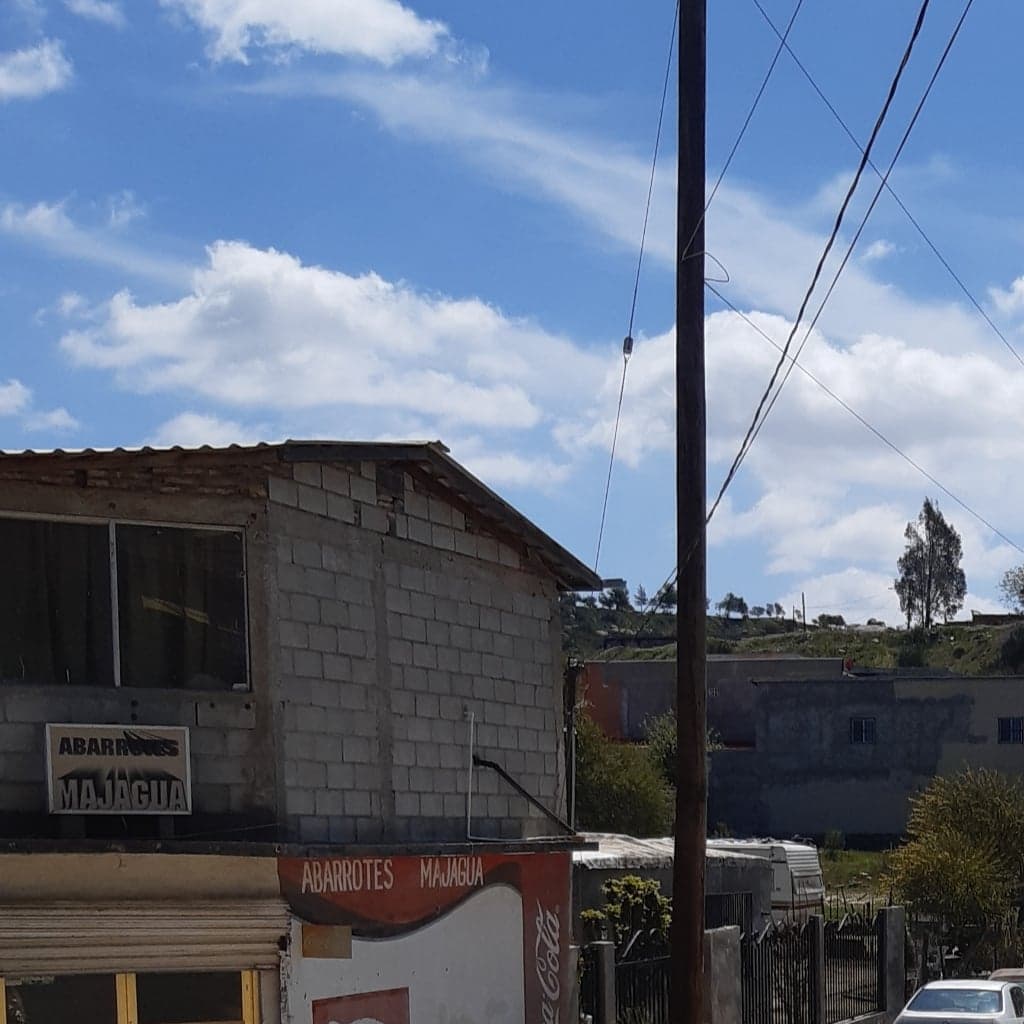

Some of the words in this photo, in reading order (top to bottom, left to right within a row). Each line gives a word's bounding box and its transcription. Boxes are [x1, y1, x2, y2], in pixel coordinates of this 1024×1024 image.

[58, 736, 180, 757] ABARRS
[57, 777, 188, 810] MAJAGUA
[301, 858, 394, 894] ABARROTES
[419, 856, 485, 889] MAJAGUA
